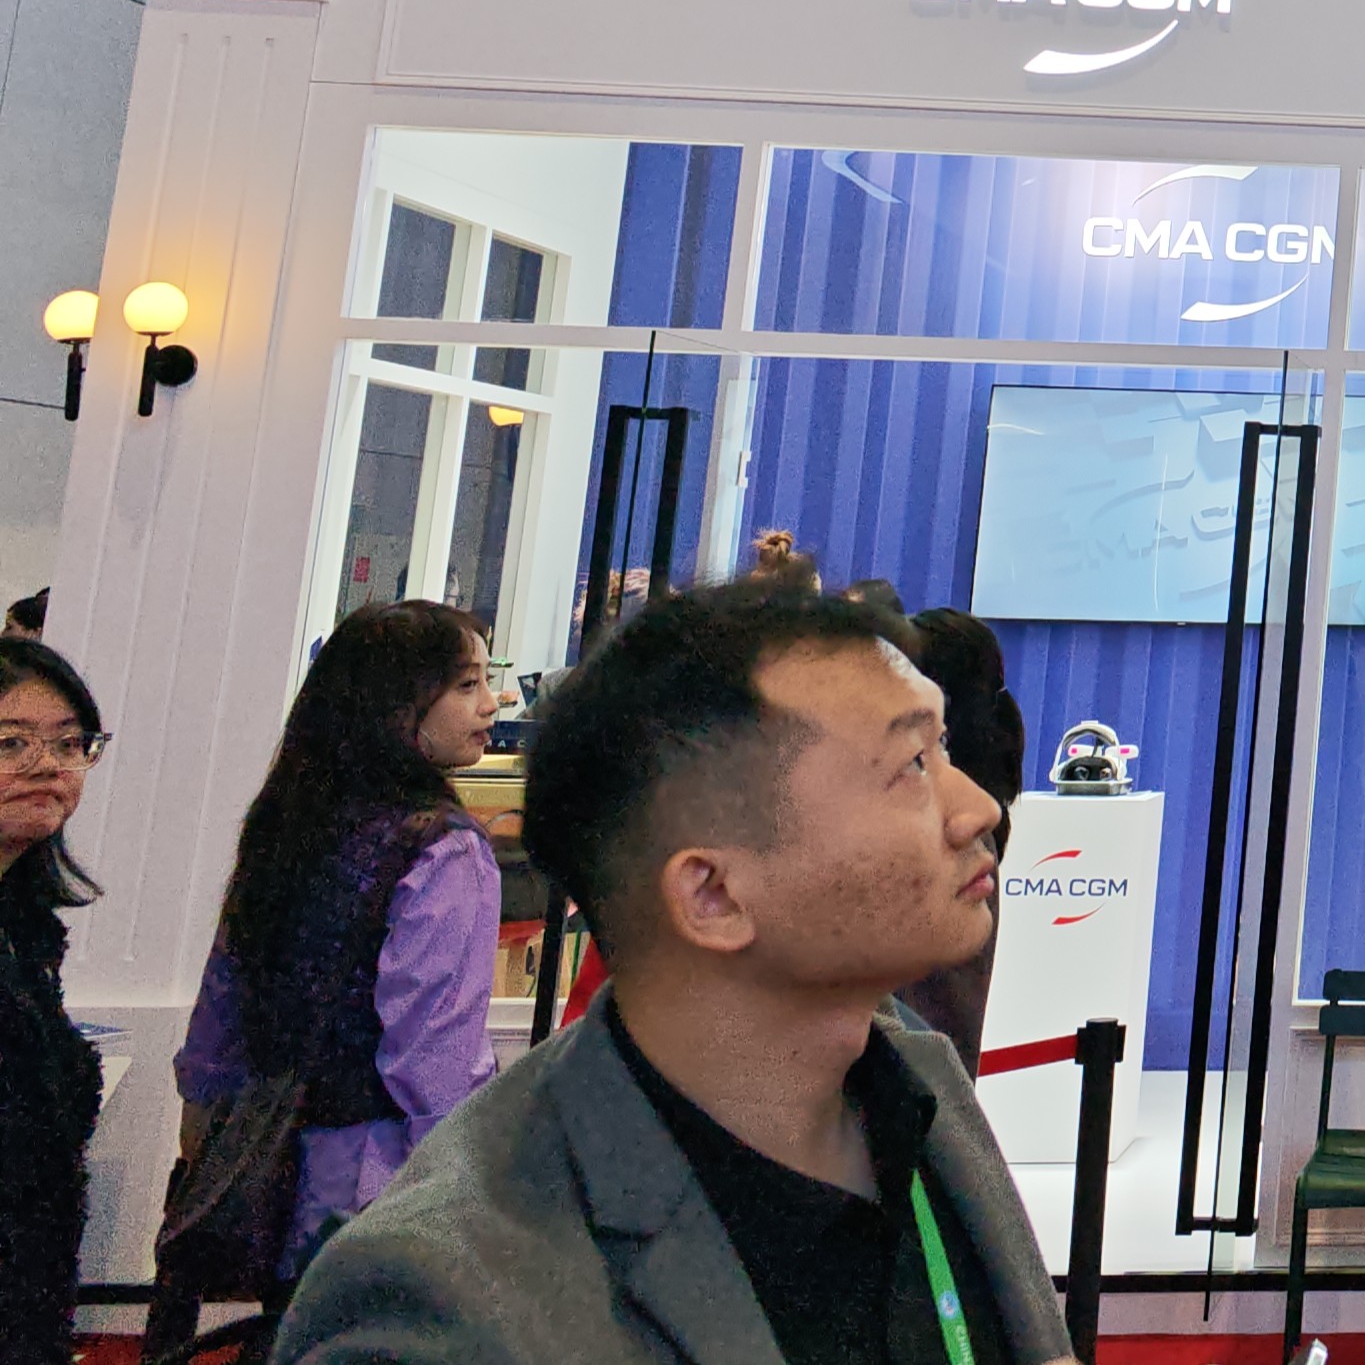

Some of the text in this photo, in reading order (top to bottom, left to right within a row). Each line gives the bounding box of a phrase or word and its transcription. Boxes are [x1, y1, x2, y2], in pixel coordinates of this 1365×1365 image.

[1082, 217, 1213, 260] CMA
[1005, 878, 1128, 897] CMA CGM
